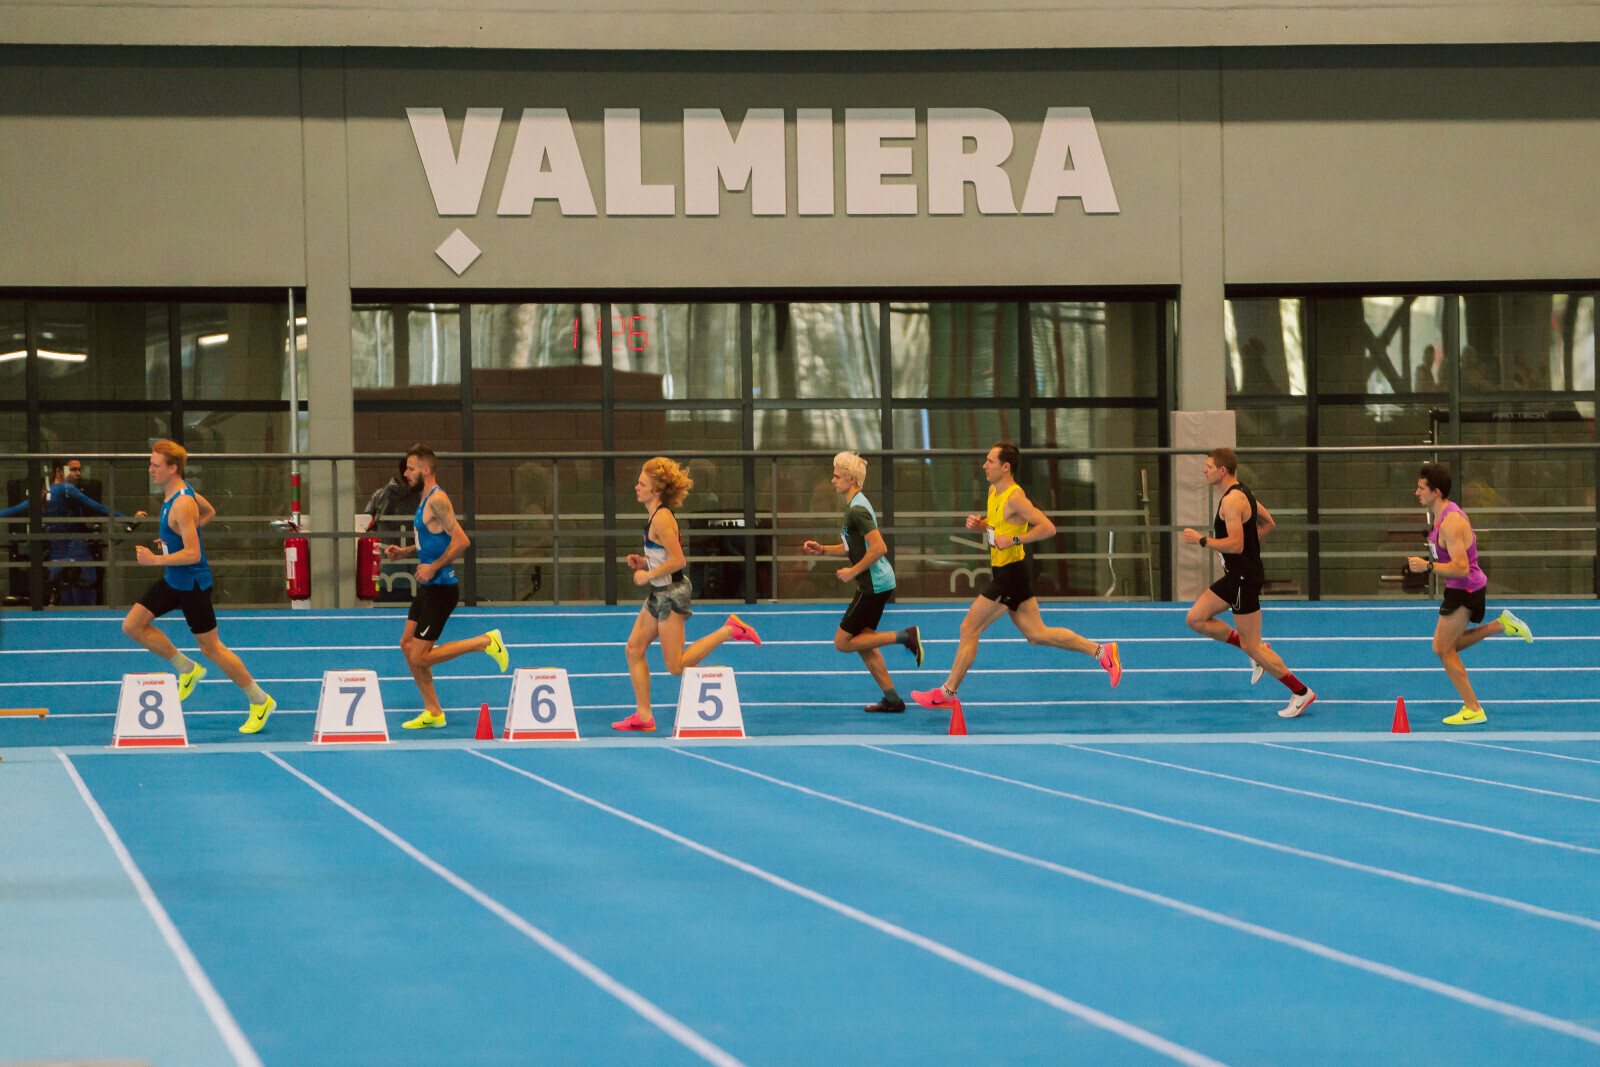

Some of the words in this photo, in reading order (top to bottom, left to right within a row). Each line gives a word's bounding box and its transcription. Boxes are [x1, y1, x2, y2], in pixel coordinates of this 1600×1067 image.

[405, 106, 1121, 216] VALMIERA
[138, 690, 165, 730] 8
[339, 686, 366, 726] 7
[530, 684, 557, 723] 6
[697, 682, 724, 721] 5
